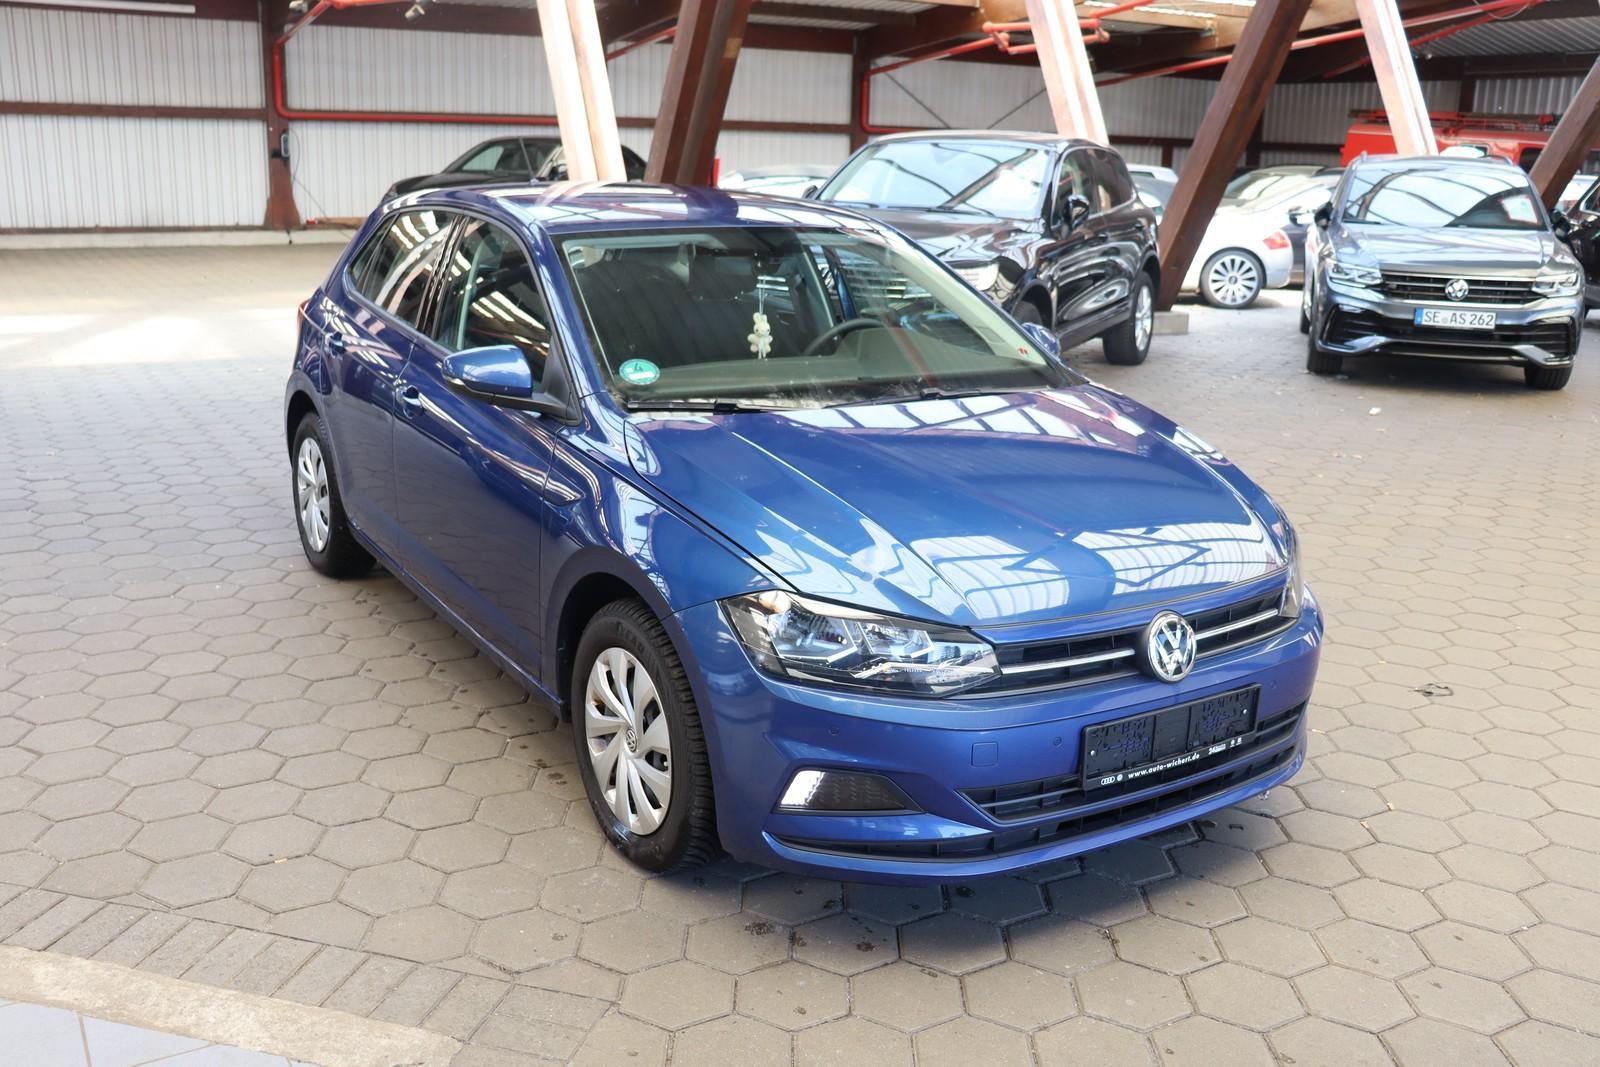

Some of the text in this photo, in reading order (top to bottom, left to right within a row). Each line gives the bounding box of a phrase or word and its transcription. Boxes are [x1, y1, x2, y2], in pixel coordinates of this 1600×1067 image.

[1424, 311, 1494, 326] SE AS 262
[1127, 752, 1200, 779] www.auto-wichert.de
